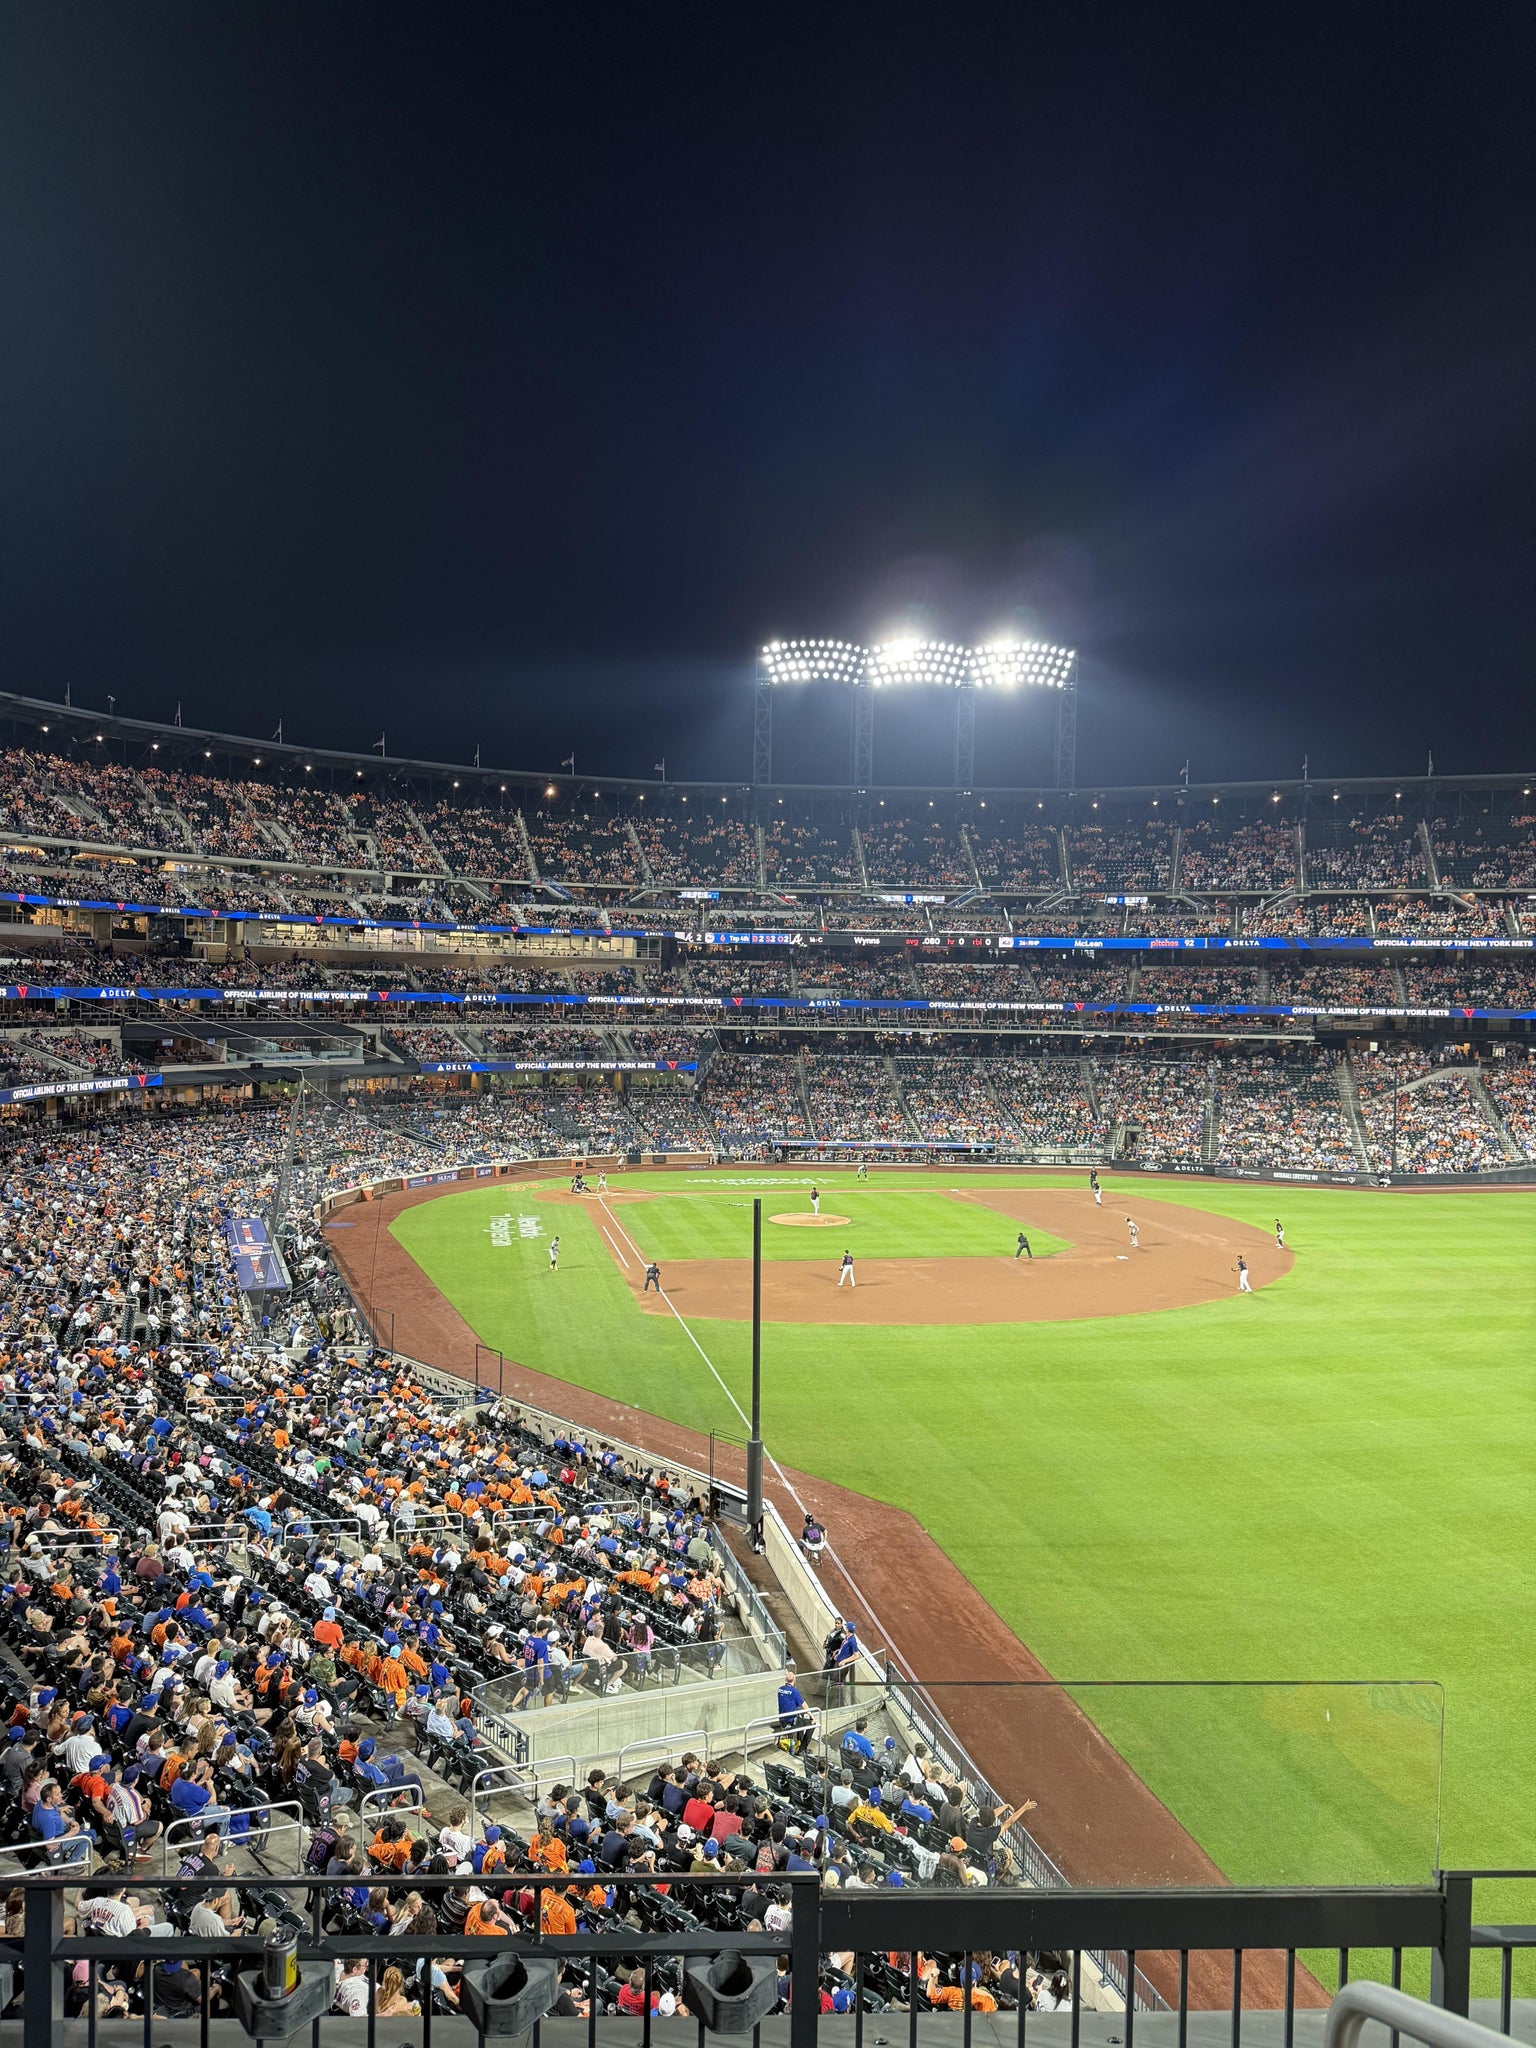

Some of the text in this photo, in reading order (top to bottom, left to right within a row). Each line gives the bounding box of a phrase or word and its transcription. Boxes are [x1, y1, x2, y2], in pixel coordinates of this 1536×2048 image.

[729, 935, 740, 943] Top
[854, 936, 880, 946] Wynns
[905, 938, 919, 946] avg
[922, 937, 941, 945] .080
[947, 937, 955, 945] hr
[958, 937, 965, 945] 0
[985, 937, 992, 945] 0
[1074, 939, 1103, 947] McLean
[1150, 939, 1178, 947] pitches
[108, 989, 136, 997] DELTA
[1428, 1008, 1450, 1016] METS
[13, 1078, 129, 1100] OFFICIAL AIRLINE OF THE NEW YORK METS
[373, 1592, 386, 1608] 31
[92, 1907, 115, 1923] WRIGHT
[770, 1914, 782, 1927] SOTO
